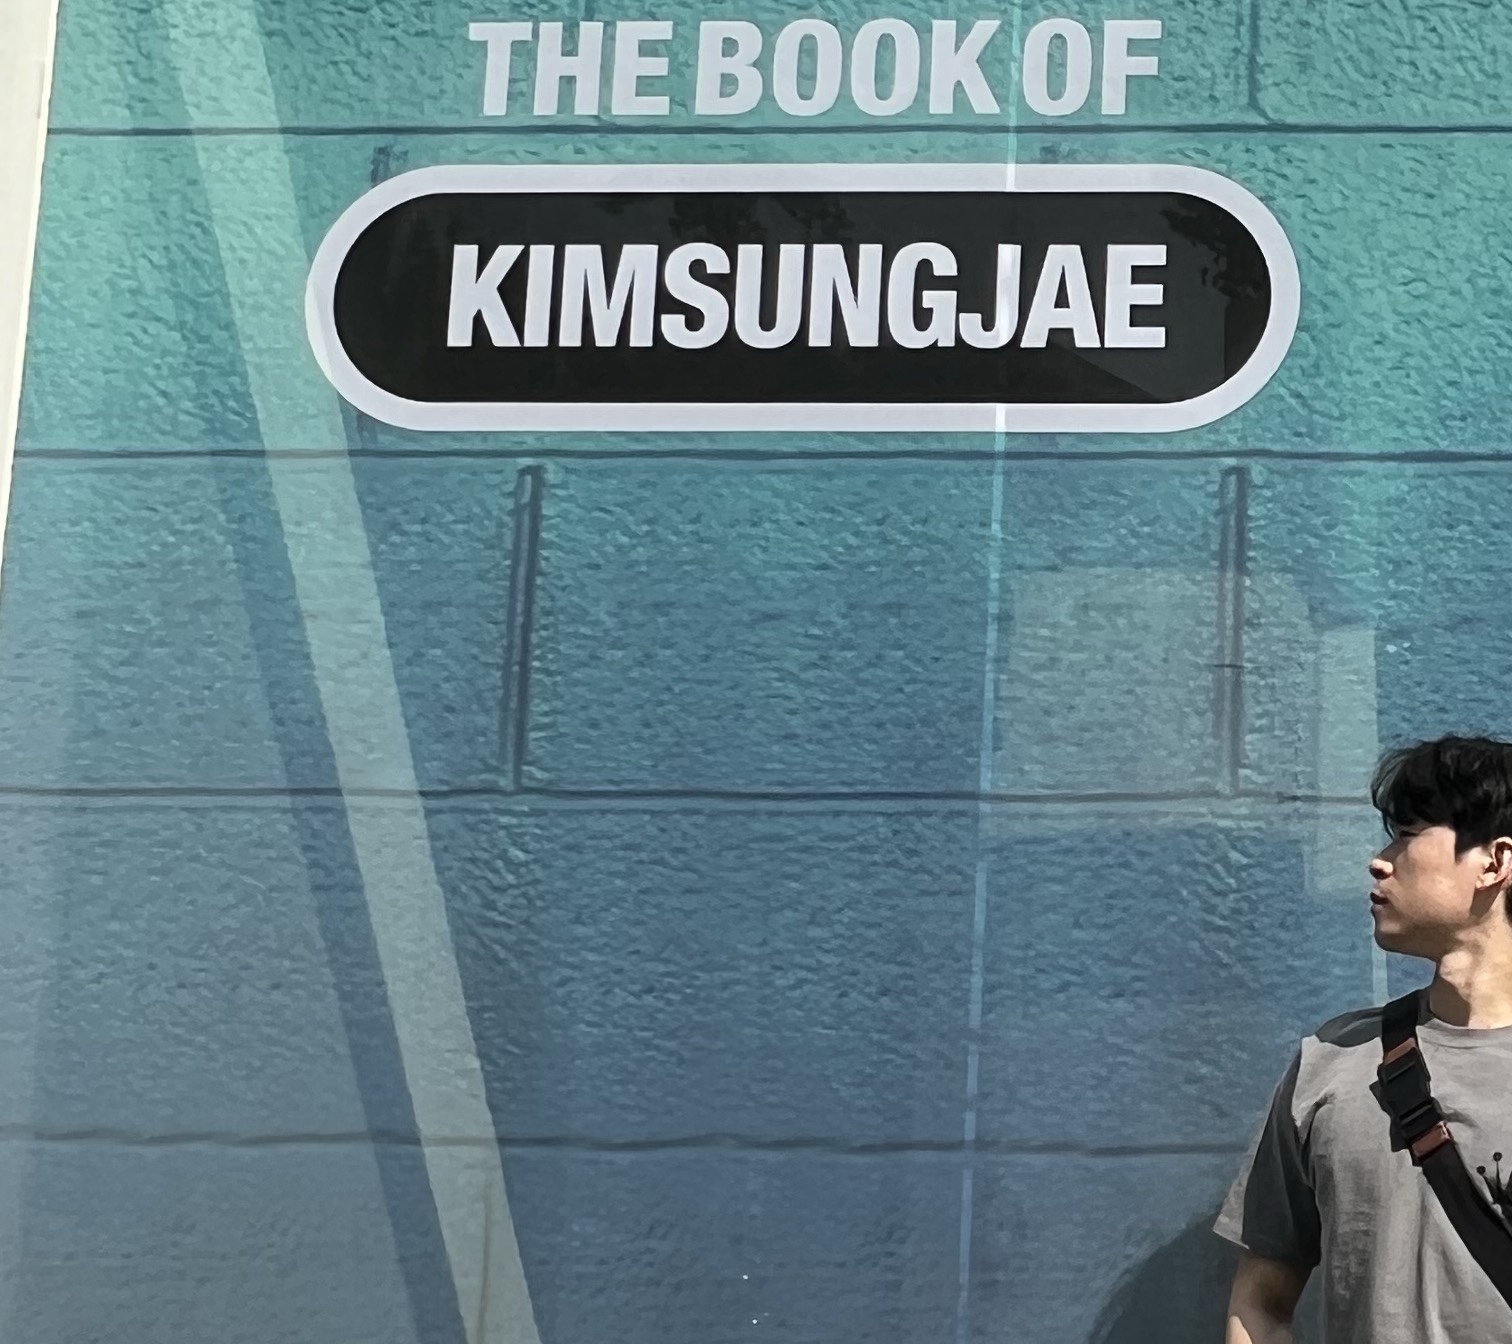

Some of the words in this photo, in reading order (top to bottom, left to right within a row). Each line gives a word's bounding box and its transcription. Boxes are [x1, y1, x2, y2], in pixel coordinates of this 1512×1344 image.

[468, 19, 673, 117] THE
[694, 18, 1001, 117] BOOK
[1021, 17, 1163, 117] OF
[446, 241, 1167, 350] KIMSUNGJAE
